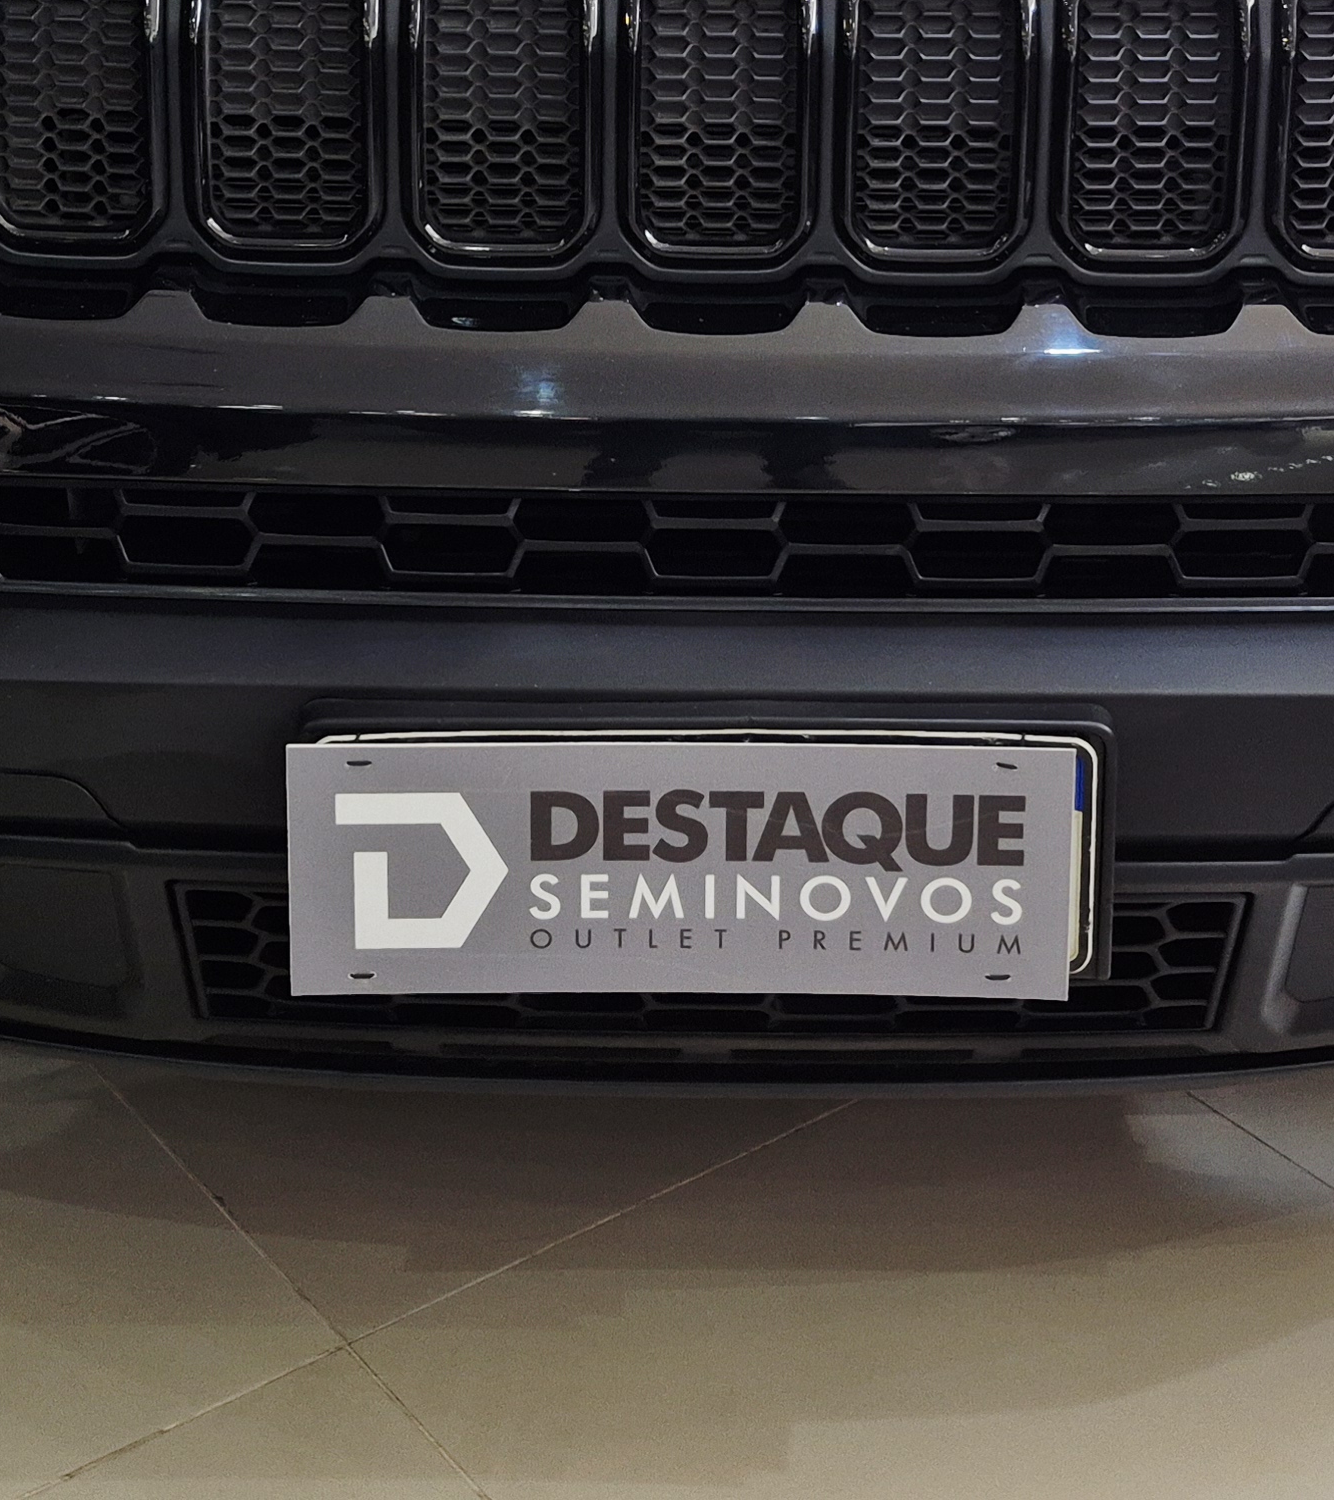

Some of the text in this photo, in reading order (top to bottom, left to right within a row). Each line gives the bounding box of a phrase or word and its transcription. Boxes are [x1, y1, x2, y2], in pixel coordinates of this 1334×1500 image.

[529, 788, 1027, 873] DESTAQUE
[529, 872, 1024, 926] SEMINOVOS
[530, 927, 1022, 956] OUTLET PREMIUM
